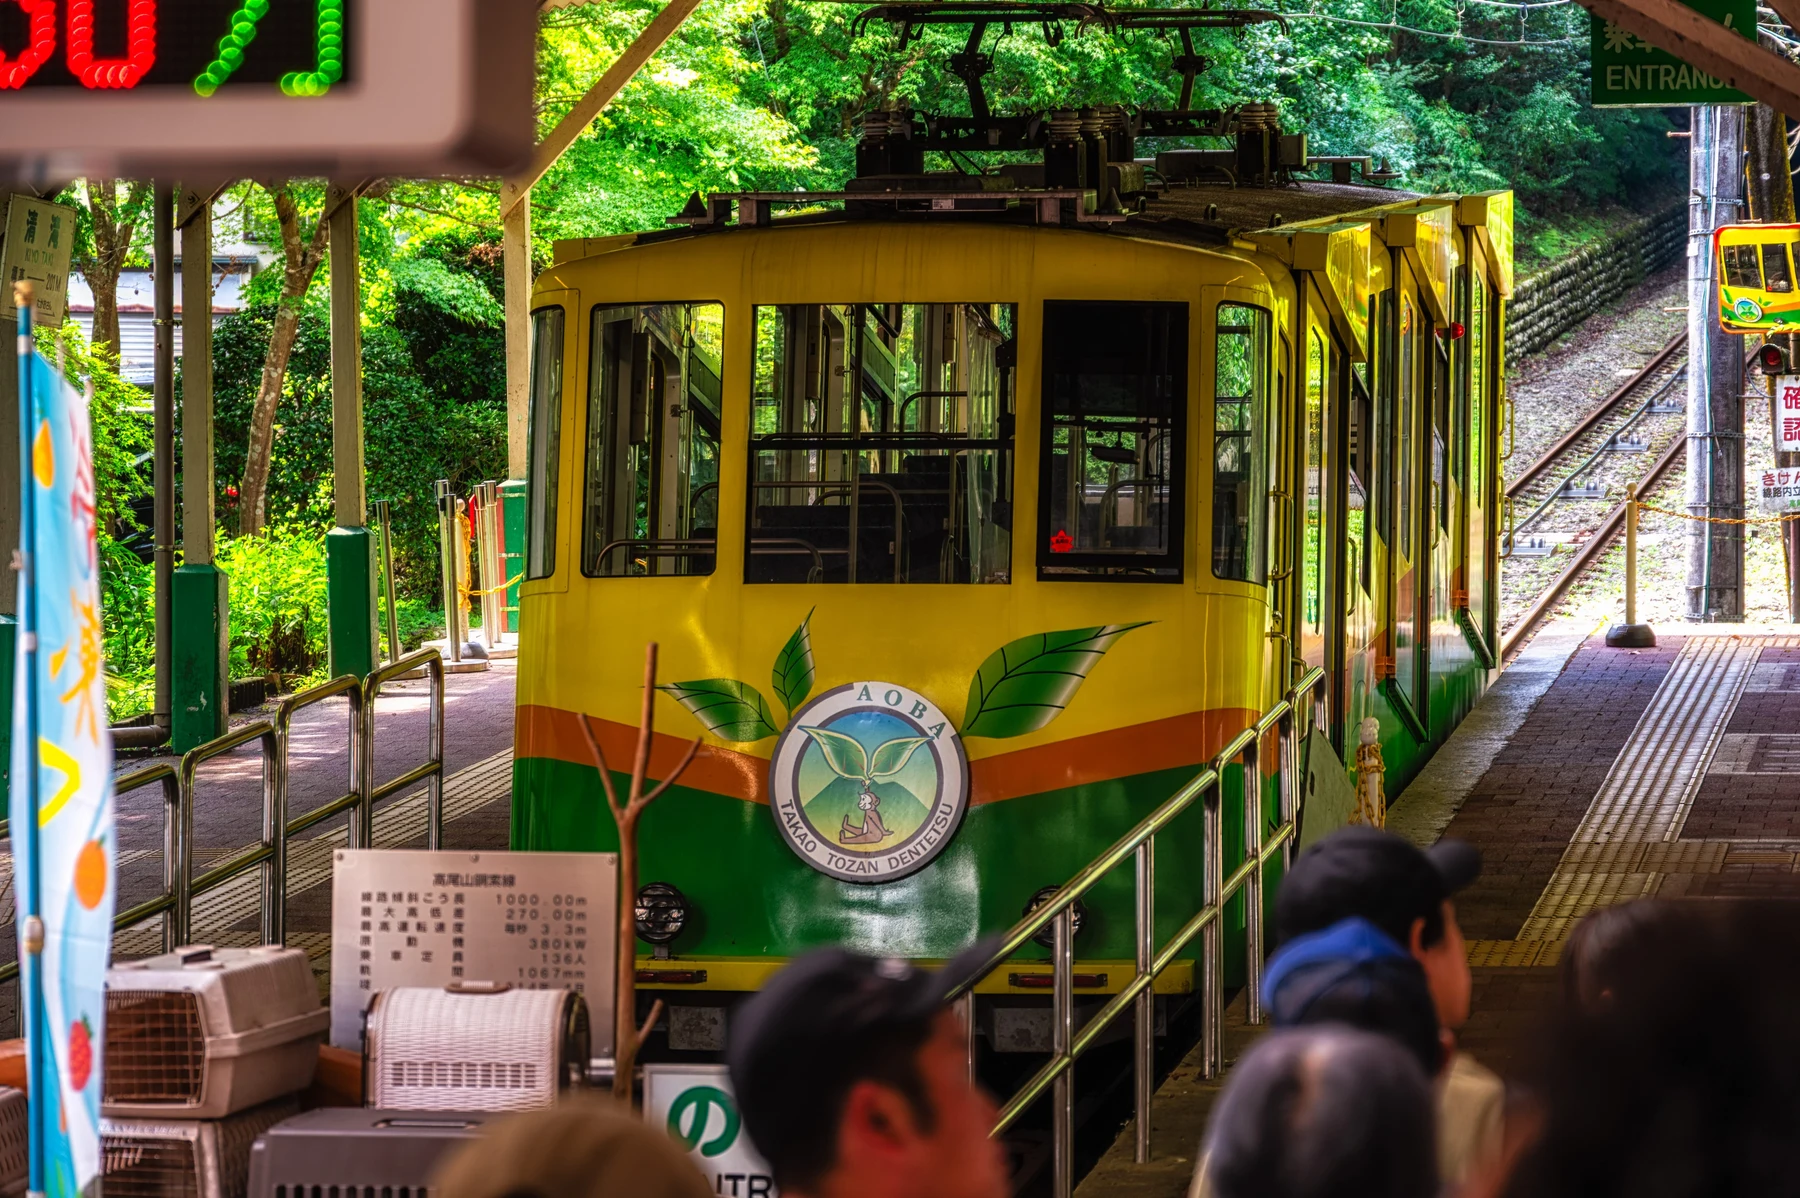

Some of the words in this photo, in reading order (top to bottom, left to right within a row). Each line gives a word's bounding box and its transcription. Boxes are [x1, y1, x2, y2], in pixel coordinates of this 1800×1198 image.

[1606, 64, 1737, 90] ENTRANC
[25, 249, 39, 263] KIYO
[857, 684, 946, 740] AOBA
[780, 798, 818, 854] TAKAO
[826, 852, 879, 875] TOZAN
[887, 802, 954, 871] DENTETSU
[518, 967, 586, 979] 1067mm
[667, 1085, 742, 1157] の
